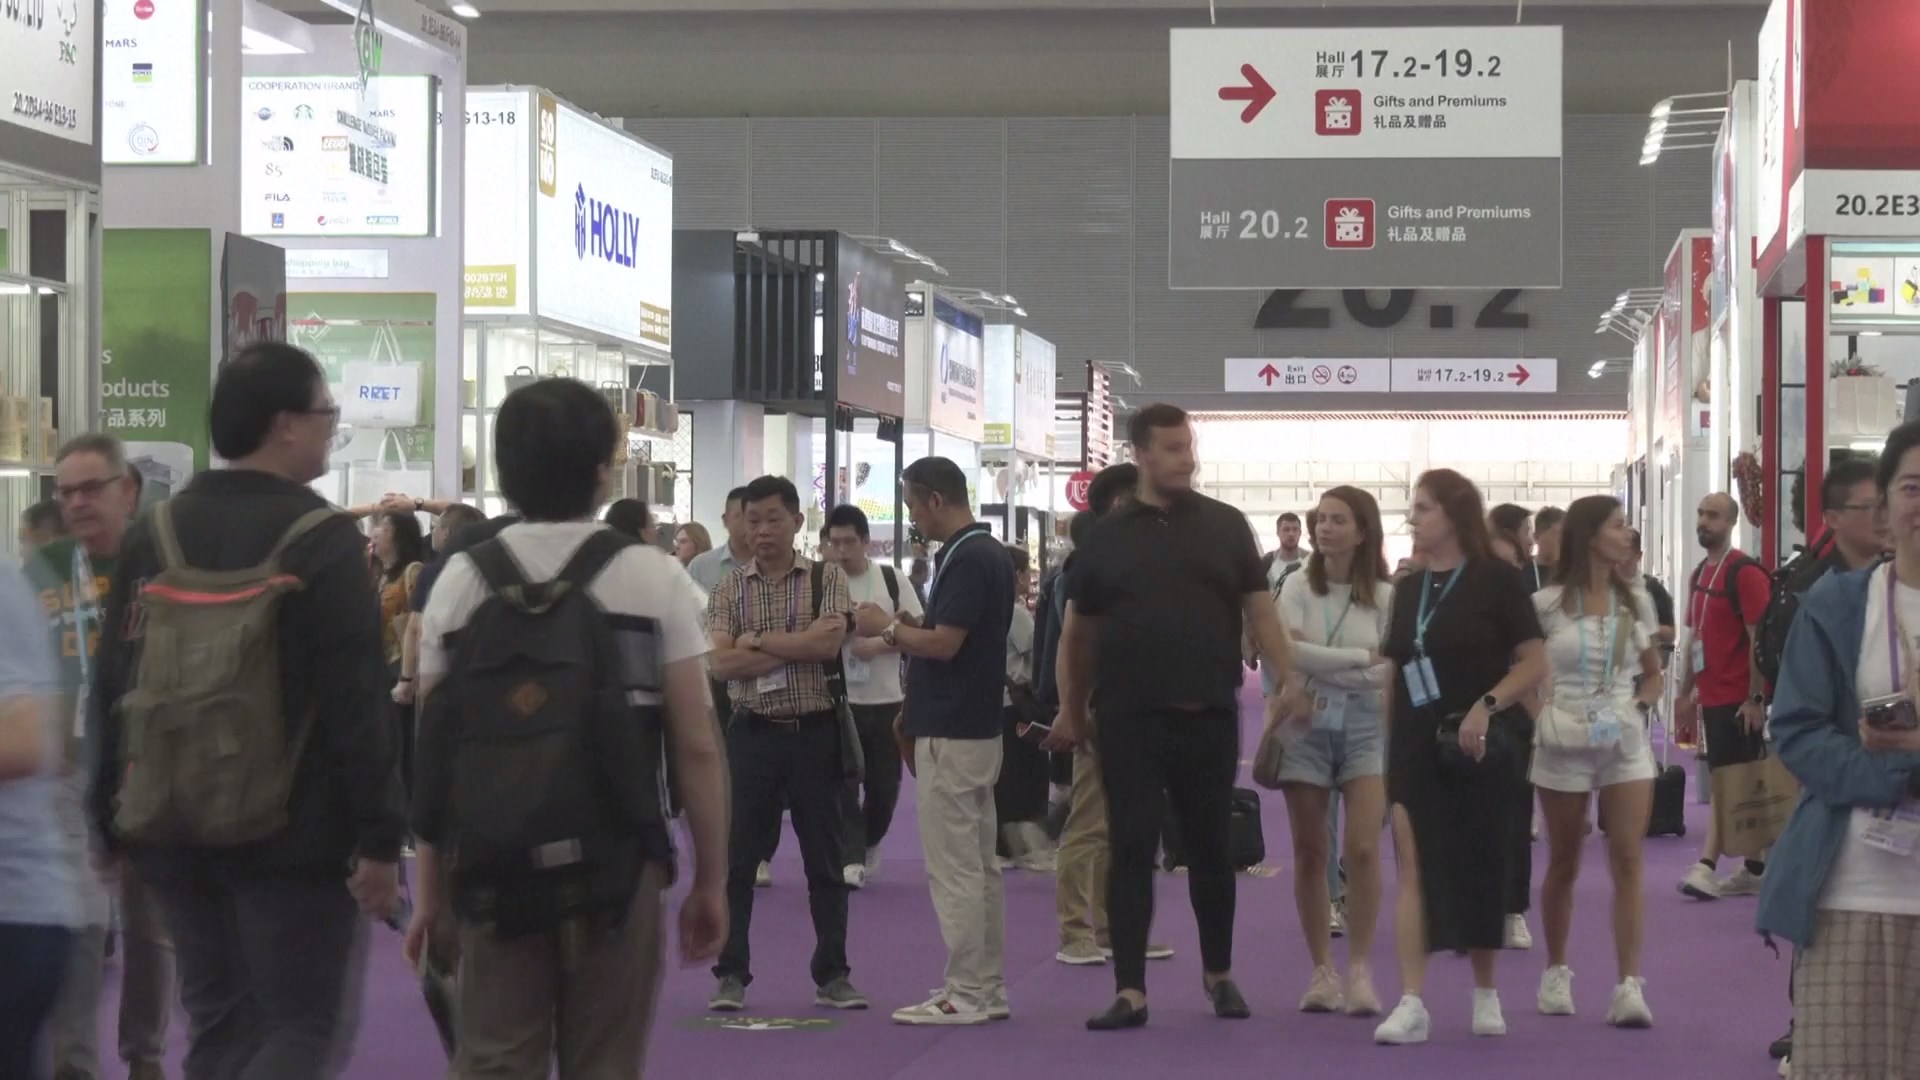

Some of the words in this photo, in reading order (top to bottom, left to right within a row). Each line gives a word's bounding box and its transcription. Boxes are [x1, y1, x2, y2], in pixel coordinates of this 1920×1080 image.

[105, 39, 138, 48] MARS
[1317, 51, 1345, 63] Hall
[1350, 48, 1501, 78] 17.2-19.2
[1316, 65, 1345, 78] 展厅
[248, 81, 321, 91] COOPERATION
[1373, 95, 1406, 108] Gifts
[1409, 95, 1434, 107] and
[1438, 95, 1507, 107] Premiums
[369, 109, 396, 118] MARS
[1373, 114, 1447, 129] 礼品及赠品
[264, 193, 291, 202] FILA
[1387, 206, 1422, 218] Gifts
[1425, 205, 1453, 218] and
[1456, 205, 1531, 218] Premiums
[1835, 194, 1920, 216] 20.2E3
[1200, 211, 1230, 225] Hall
[1239, 209, 1308, 239] 20.2
[590, 198, 640, 269] HOLLY
[1200, 225, 1229, 239] 展厅
[1387, 226, 1466, 242] 礼品及赠品
[1285, 374, 1306, 384] 出口
[1435, 368, 1504, 382] 17.2-19.2
[102, 377, 170, 397] oducts
